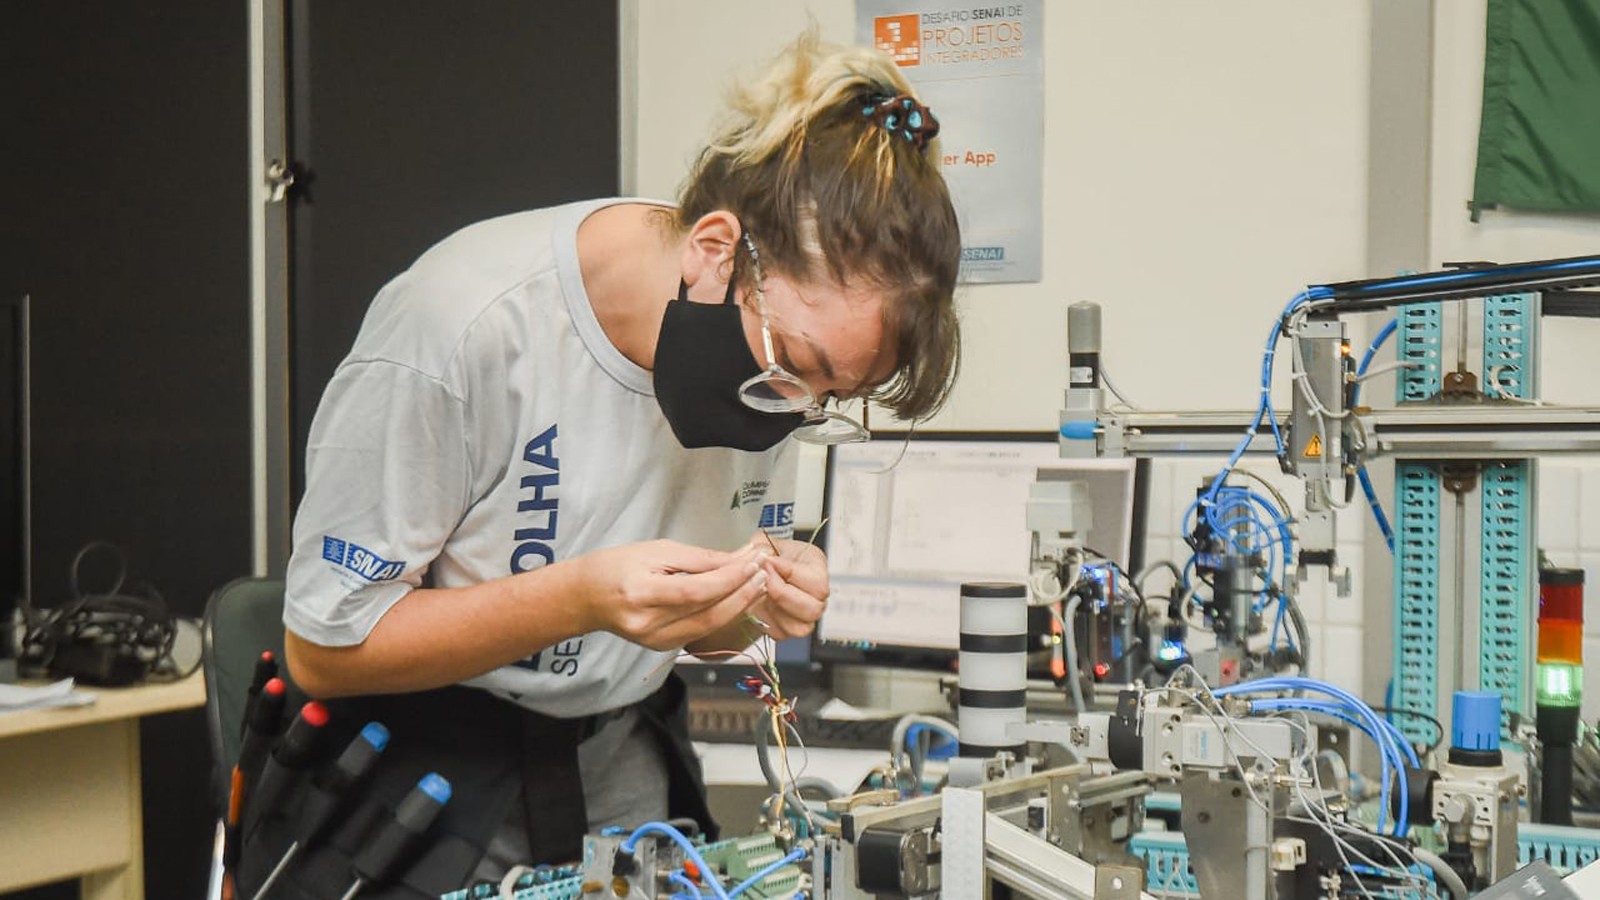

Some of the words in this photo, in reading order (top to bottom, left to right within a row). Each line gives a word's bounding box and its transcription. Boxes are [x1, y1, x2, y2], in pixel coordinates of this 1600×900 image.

[922, 11, 970, 25] DESAFIO
[971, 8, 1005, 20] SENAI
[1008, 5, 1023, 17] DE
[922, 22, 1023, 48] PROJETOS
[922, 45, 1024, 65] INTEGRADORES
[943, 154, 959, 166] er
[964, 150, 996, 167] App
[962, 249, 1004, 260] SENAI
[550, 639, 583, 677] SE
